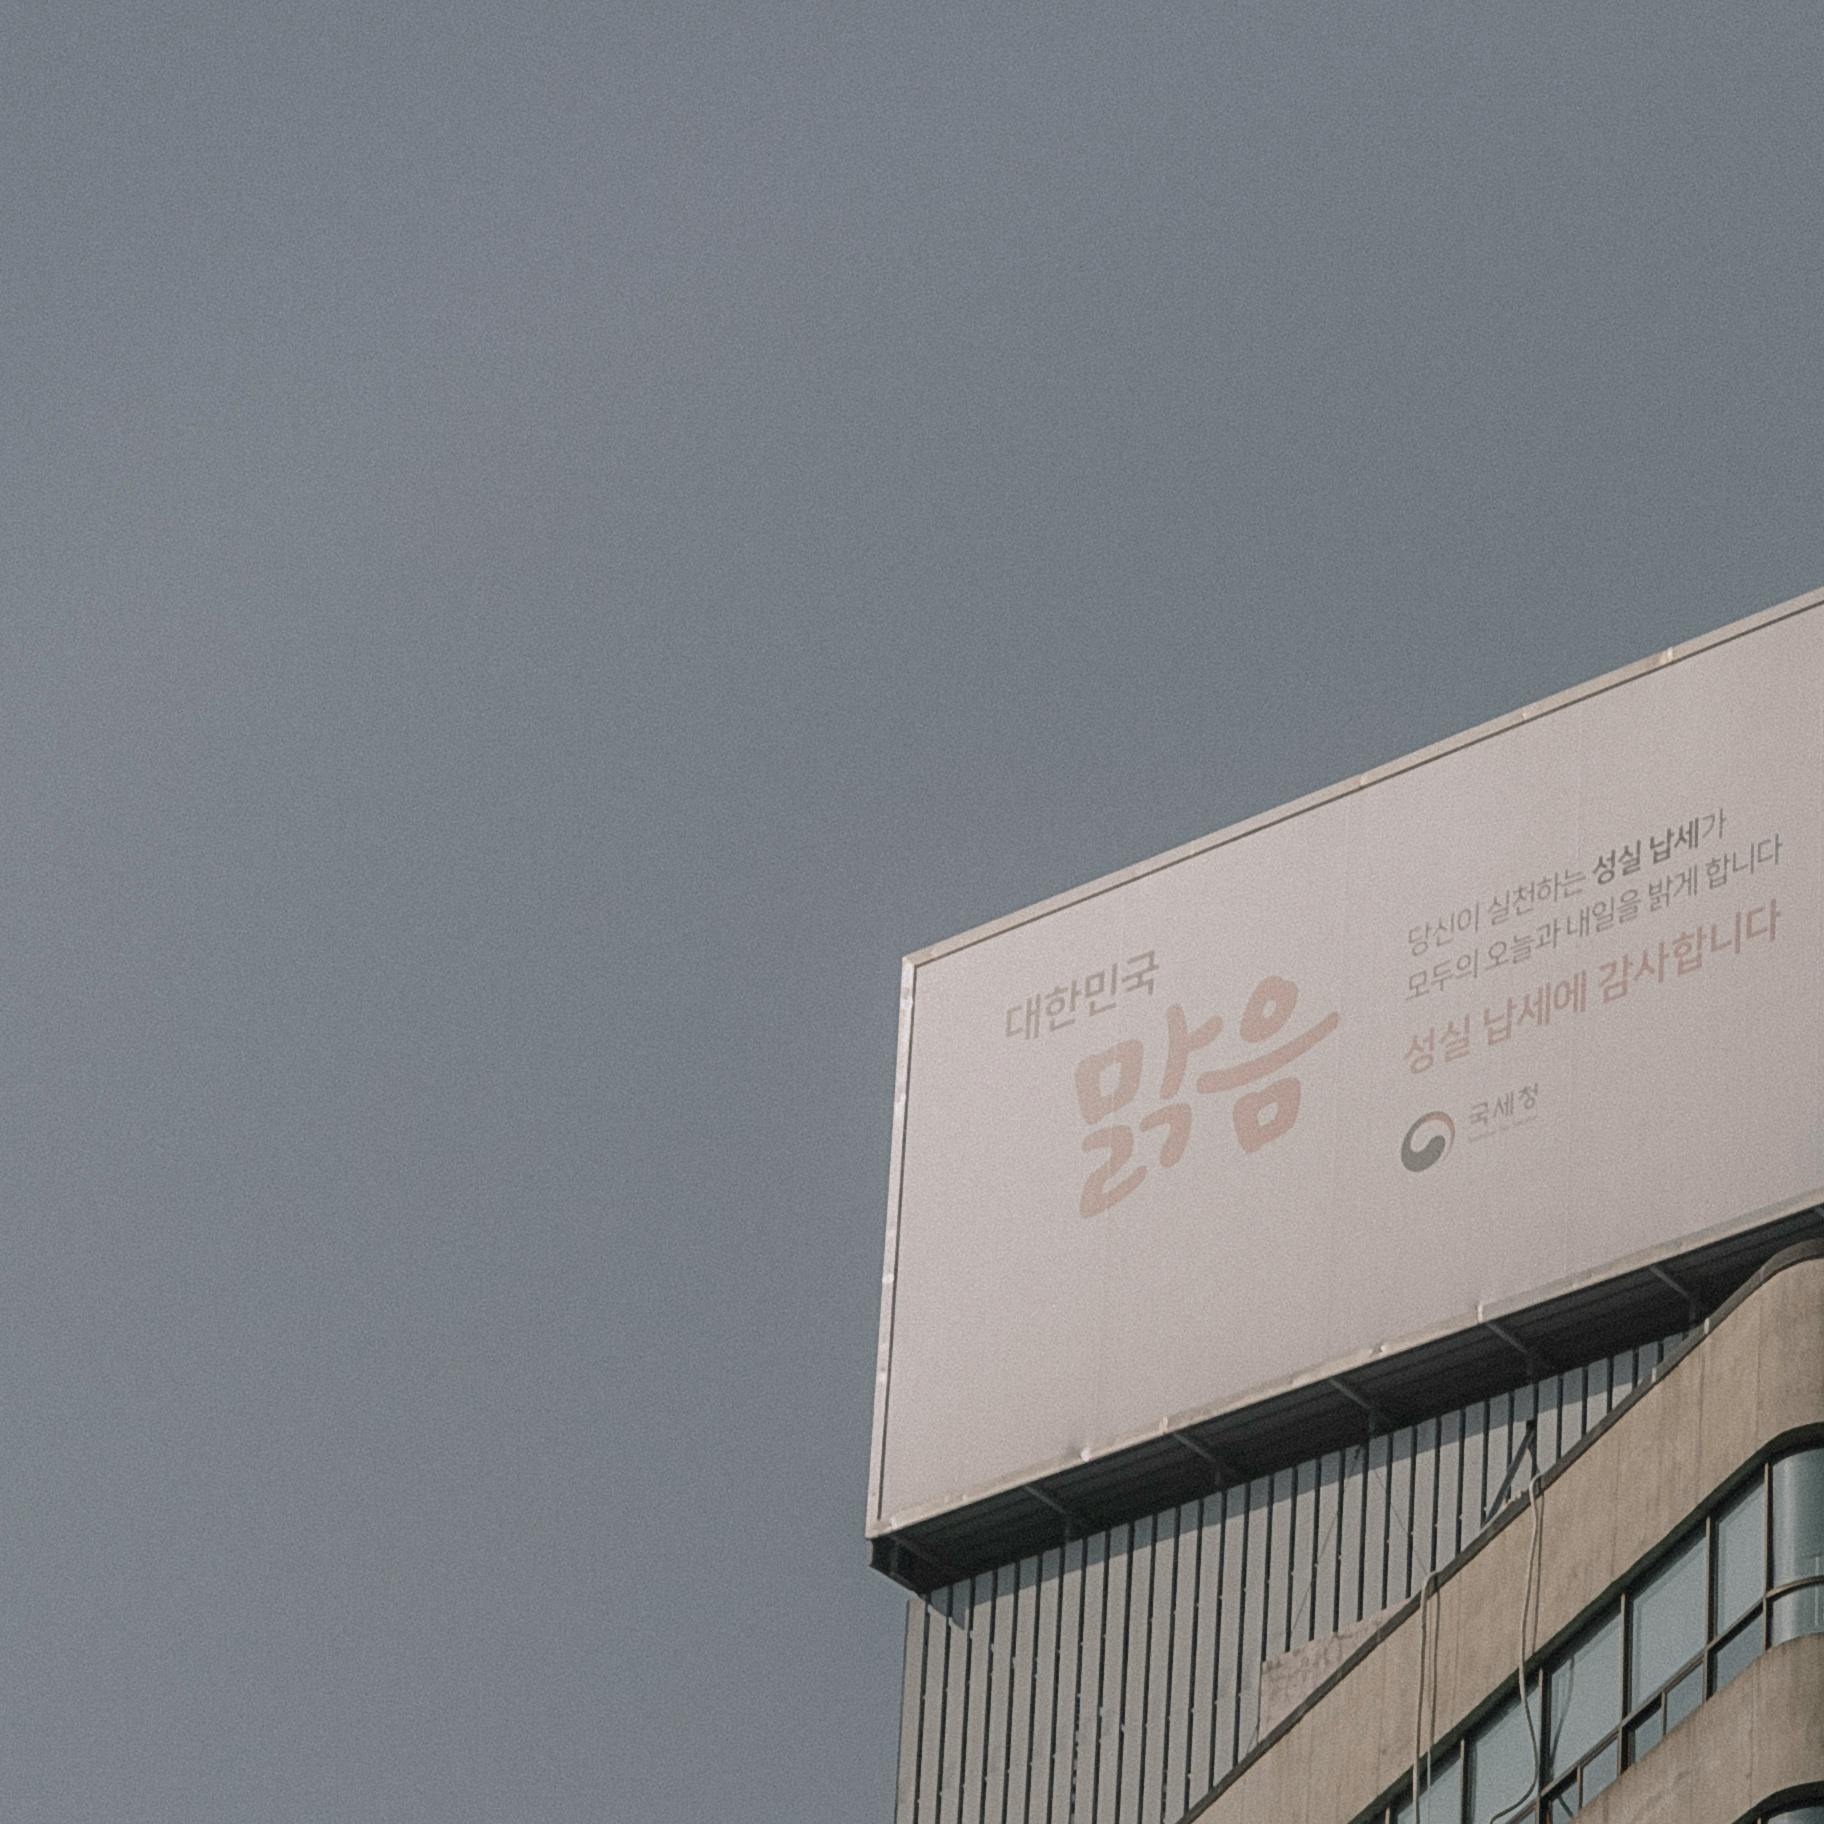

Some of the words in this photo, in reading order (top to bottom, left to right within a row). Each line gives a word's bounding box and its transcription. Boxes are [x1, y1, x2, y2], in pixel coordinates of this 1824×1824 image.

[1593, 839, 1643, 885] 성실
[1705, 833, 1783, 890] 합니다
[1005, 950, 1160, 1040] 대한민국
[1404, 1013, 1472, 1074] 성실
[1483, 970, 1588, 1047] 납세에
[1599, 898, 1782, 1004] 감사합니다
[1073, 974, 1341, 1219] 맑음
